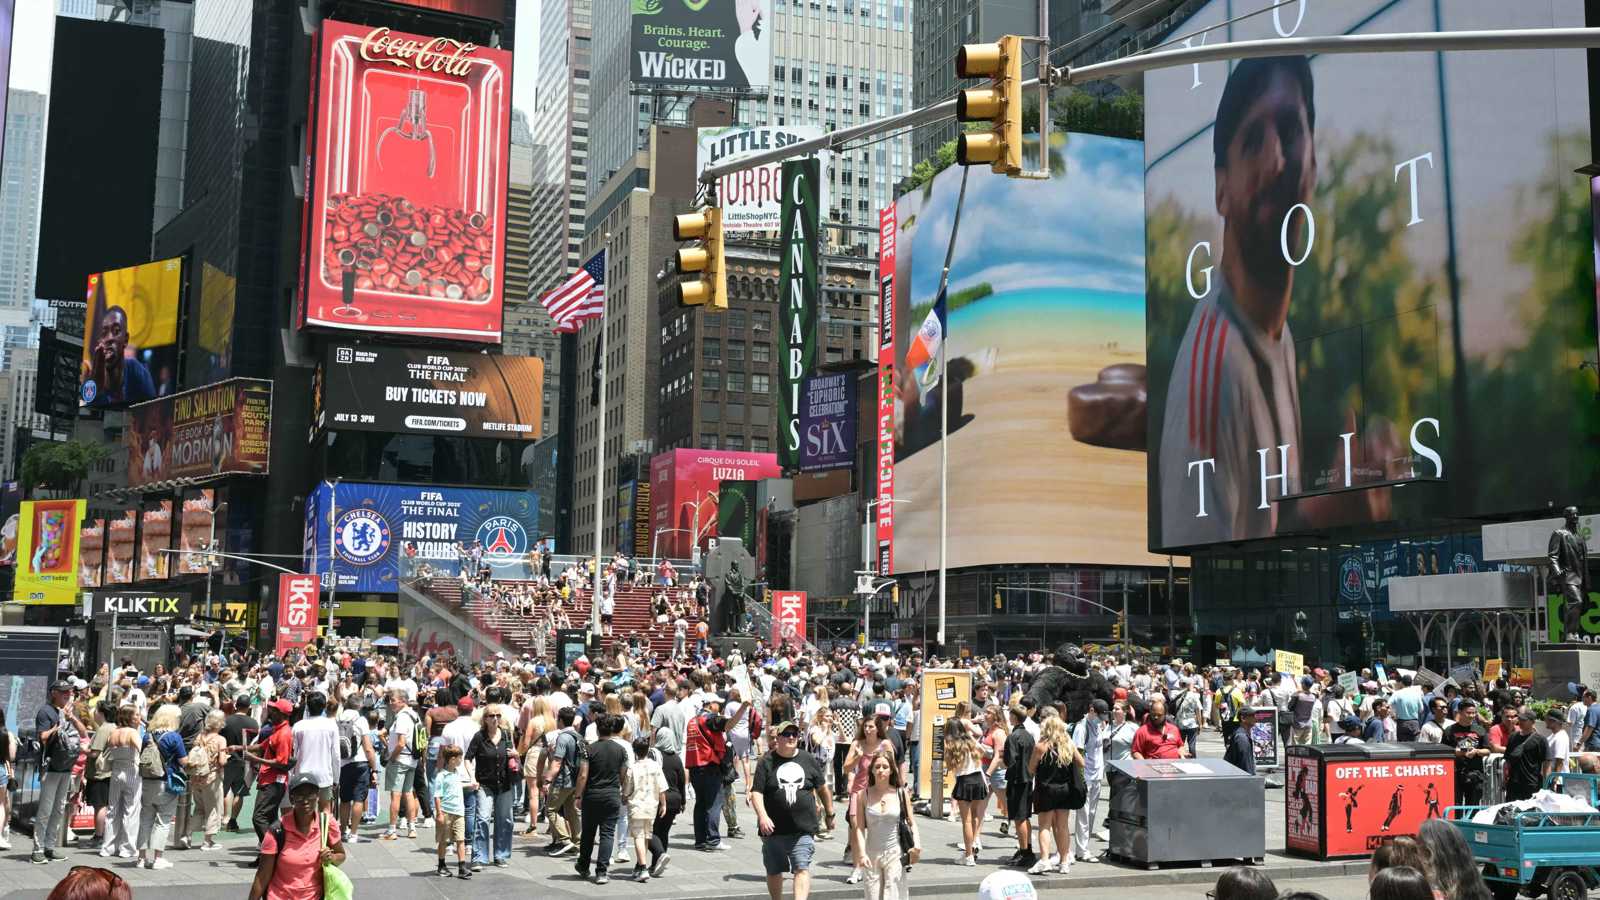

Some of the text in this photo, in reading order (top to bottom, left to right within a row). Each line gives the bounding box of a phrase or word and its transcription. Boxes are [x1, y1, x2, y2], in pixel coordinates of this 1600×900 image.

[643, 24, 725, 38] Brains. Heart.
[360, 27, 480, 77] Coca-Cola
[658, 37, 711, 51] Courage.
[710, 130, 771, 166] LITTLE
[715, 166, 782, 208] ORRO
[789, 173, 806, 453] CANNABIS
[427, 355, 450, 366] FIFA
[408, 369, 466, 382] THE FINAL
[810, 374, 846, 391] BROADWAY'S
[174, 384, 236, 423] FIND SALVATION
[385, 386, 487, 407] BUY TICKETS NOW
[241, 411, 271, 420] SOUTH
[244, 419, 265, 427] PARK
[334, 413, 375, 424] JULY 13 3PM
[411, 418, 459, 429] FIFA.COM/TICKETS
[482, 423, 533, 433] METLIFE STADIUM
[240, 440, 268, 448] ROBERT
[807, 421, 848, 457] SIX
[173, 432, 233, 466] MORMN
[241, 447, 267, 455] LOPEZ
[698, 457, 724, 466] CIRQUE
[736, 458, 759, 467] SOLEIL
[1188, 417, 1443, 518] THIS
[713, 467, 745, 481] LUZIA
[420, 492, 443, 502] FIFA
[636, 482, 651, 521] PATRICIA
[344, 510, 382, 526] CHELSEA
[401, 506, 460, 517] THE FINAL
[403, 521, 458, 540] HISTORY
[485, 518, 518, 534] PARIS
[416, 541, 458, 560] YOURS
[104, 597, 180, 613] KLIKTIX
[288, 578, 315, 626] tkts
[781, 594, 801, 639] tkts
[1335, 764, 1448, 779] OFF. THE. CHARTS.
